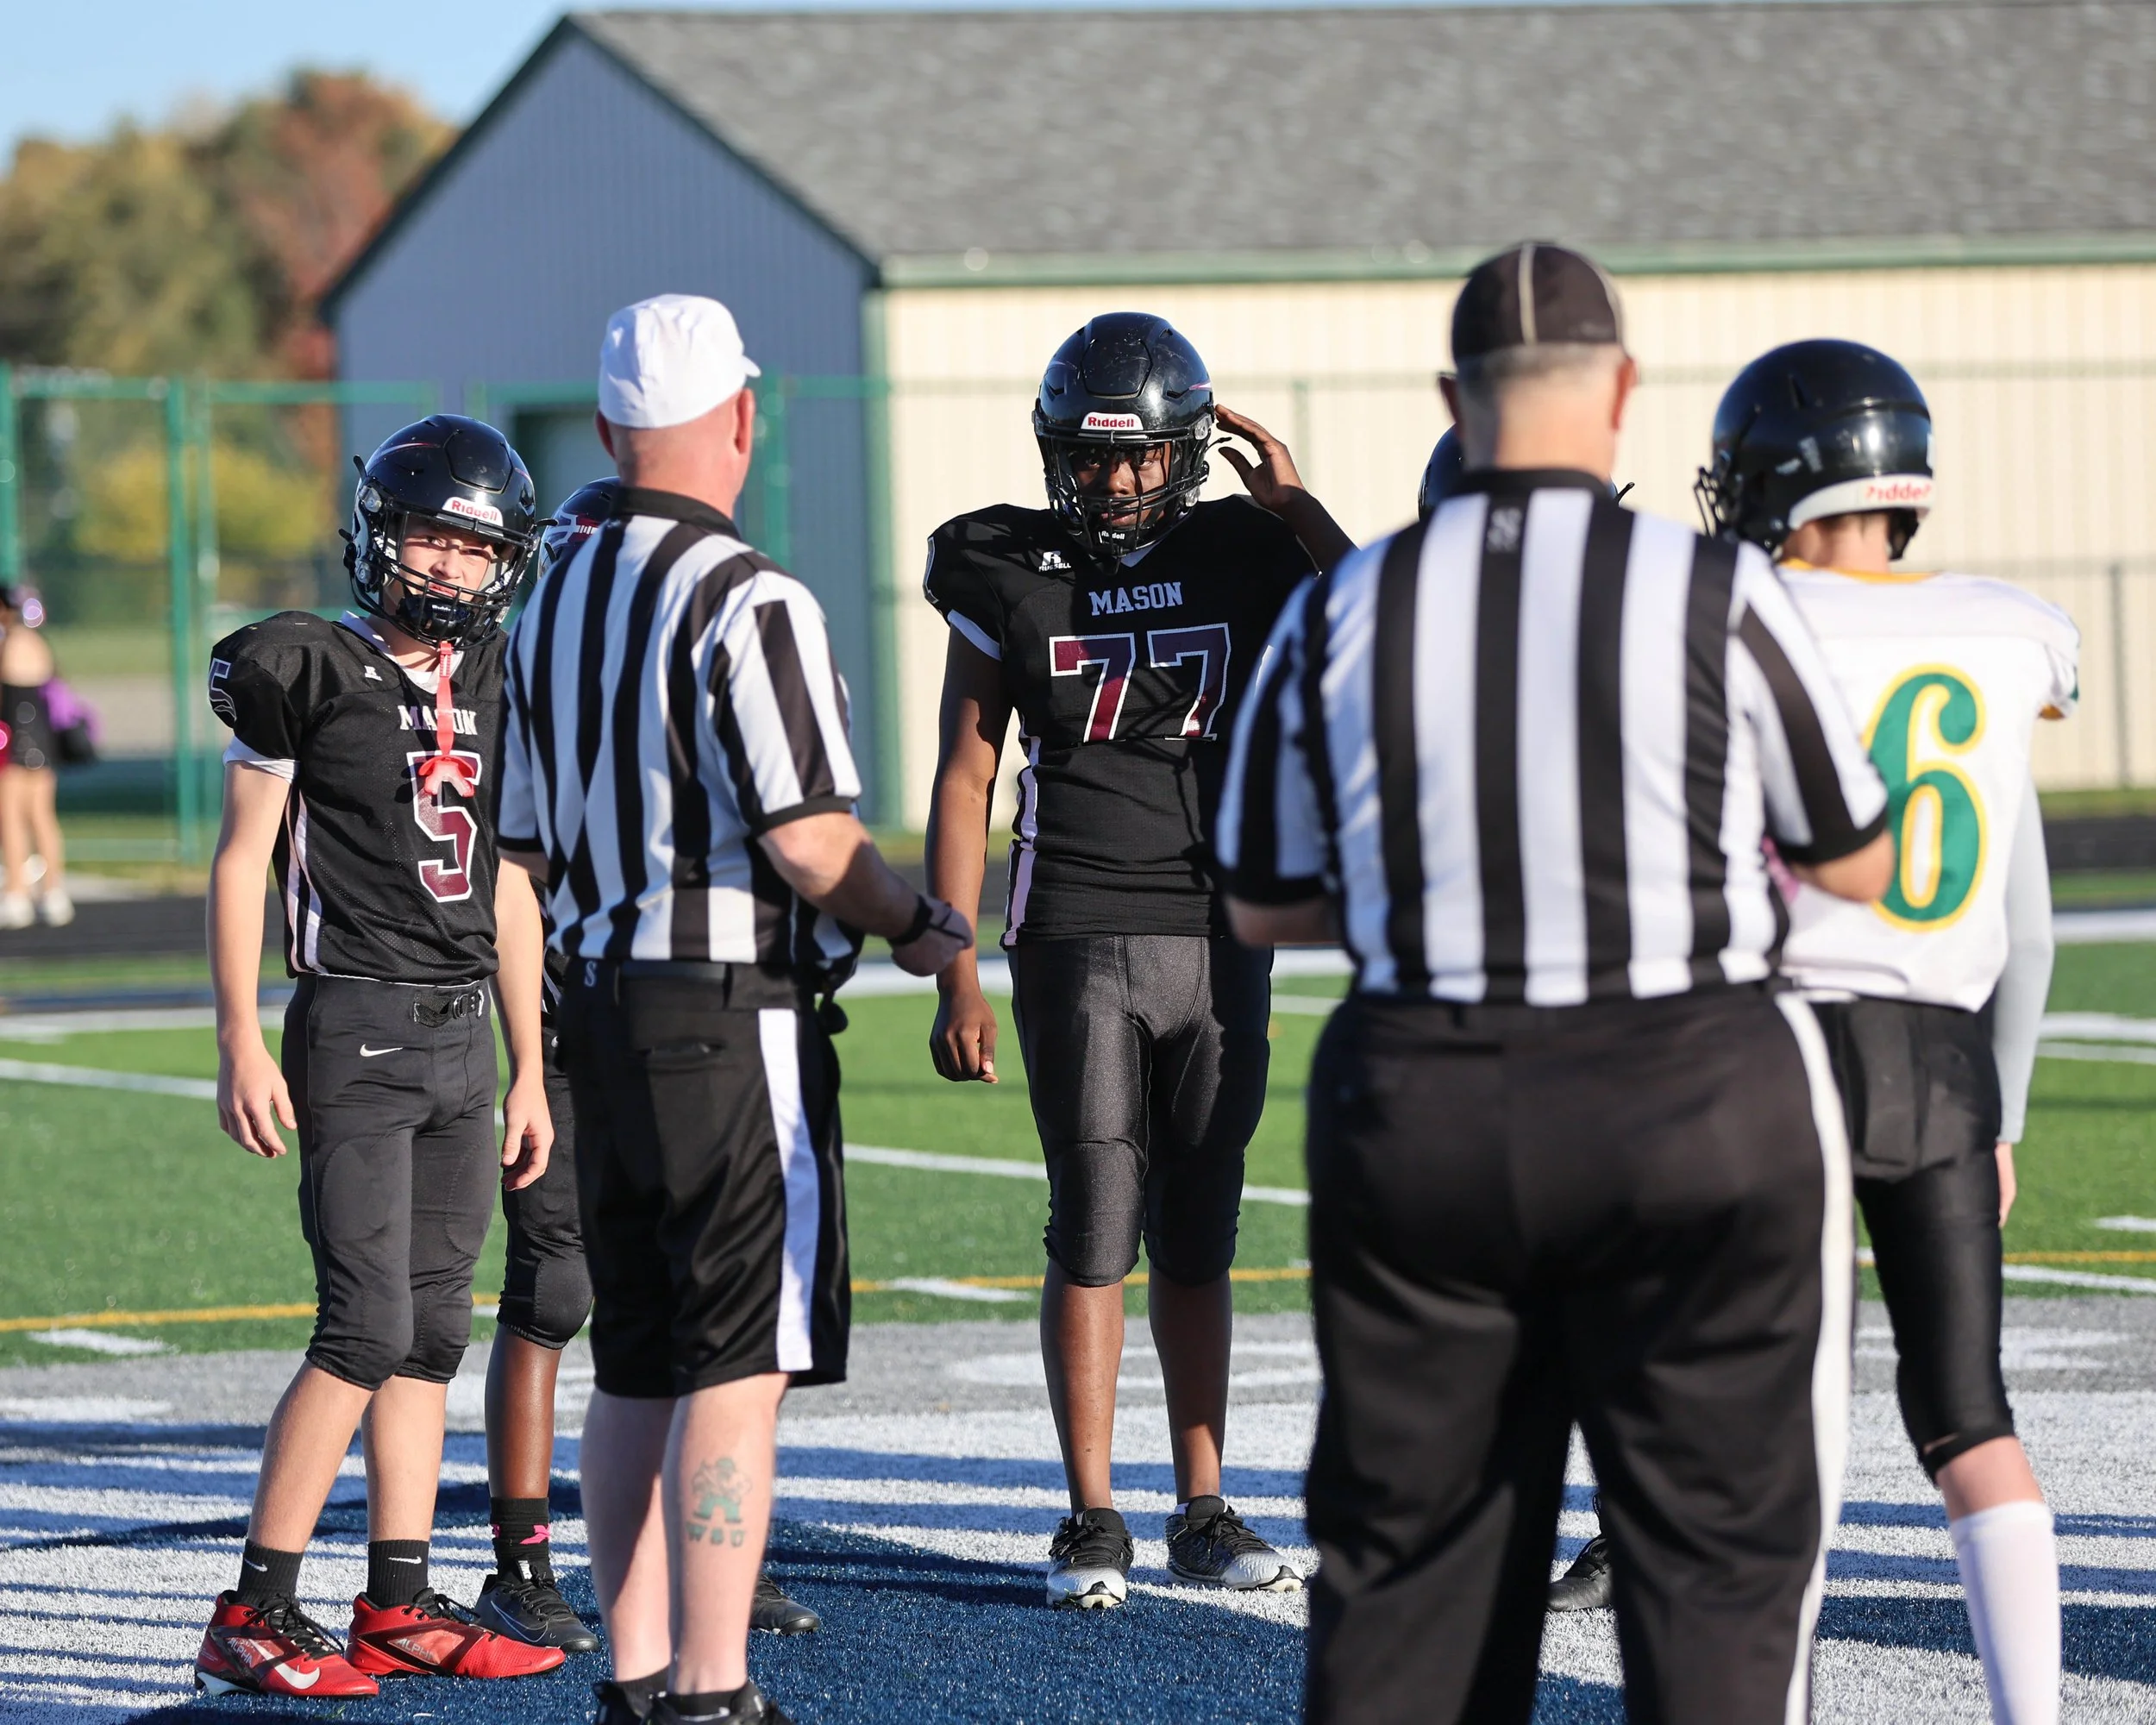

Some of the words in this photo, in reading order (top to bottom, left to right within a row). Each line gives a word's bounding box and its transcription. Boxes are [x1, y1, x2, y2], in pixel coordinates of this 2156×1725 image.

[1087, 417, 1134, 427] Riddell
[451, 500, 498, 521] Riddell
[1101, 530, 1125, 540] Ridell
[1038, 561, 1072, 572] RUSSELL
[1088, 581, 1183, 616] MASON
[1049, 623, 1231, 743] 77
[398, 705, 478, 736] MAON
[1860, 662, 1986, 933] 6
[406, 750, 482, 903] 5
[584, 960, 597, 988] S
